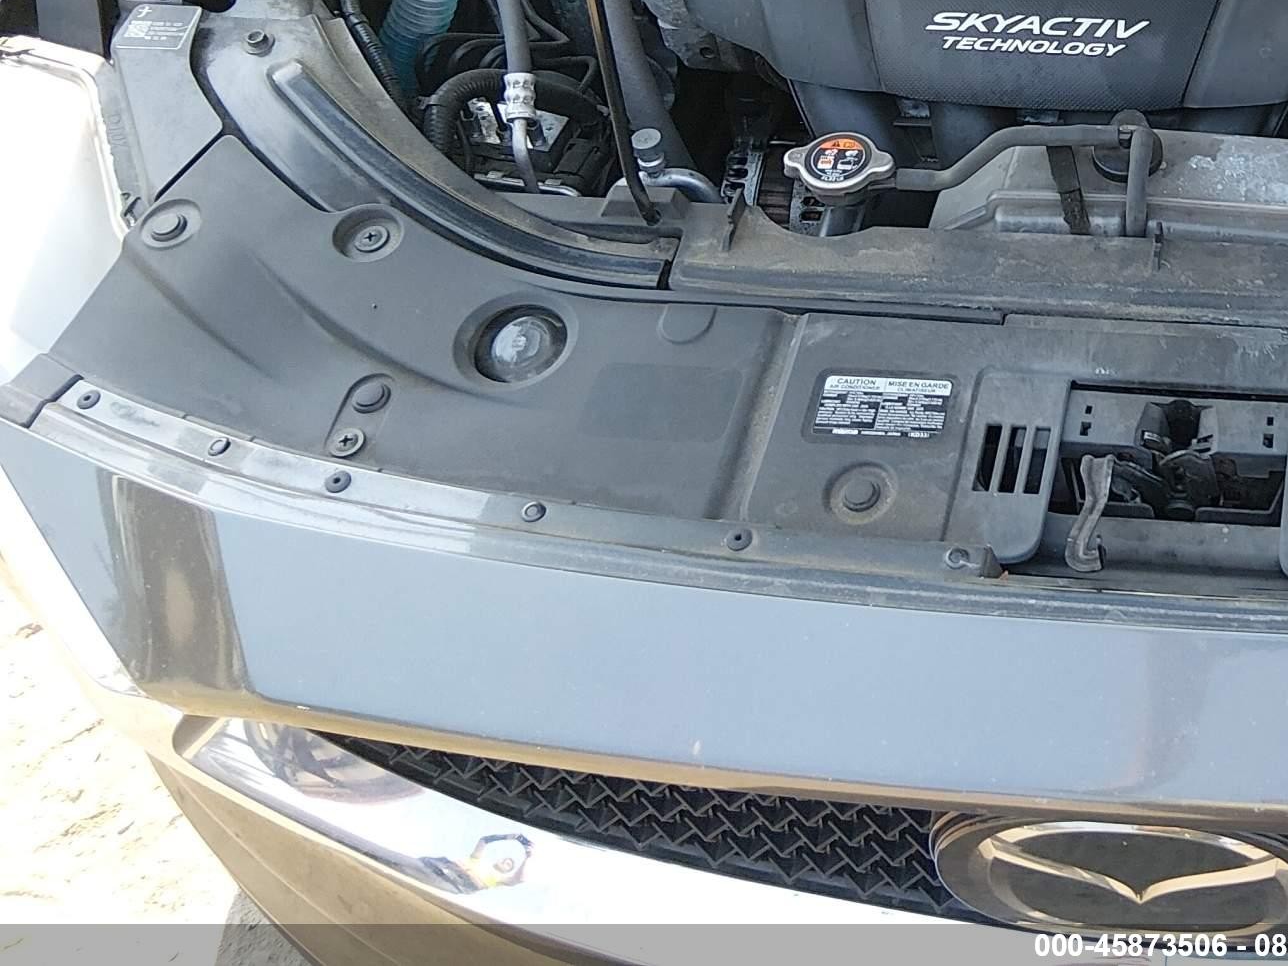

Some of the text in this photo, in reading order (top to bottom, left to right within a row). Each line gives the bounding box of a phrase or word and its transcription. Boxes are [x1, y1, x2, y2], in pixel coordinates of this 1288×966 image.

[925, 11, 1150, 39] SKYACTIV
[942, 35, 1126, 57] TECHNOLOGY
[836, 377, 877, 386] CAUTION
[888, 380, 907, 388] MISE
[921, 381, 949, 389] GARDE
